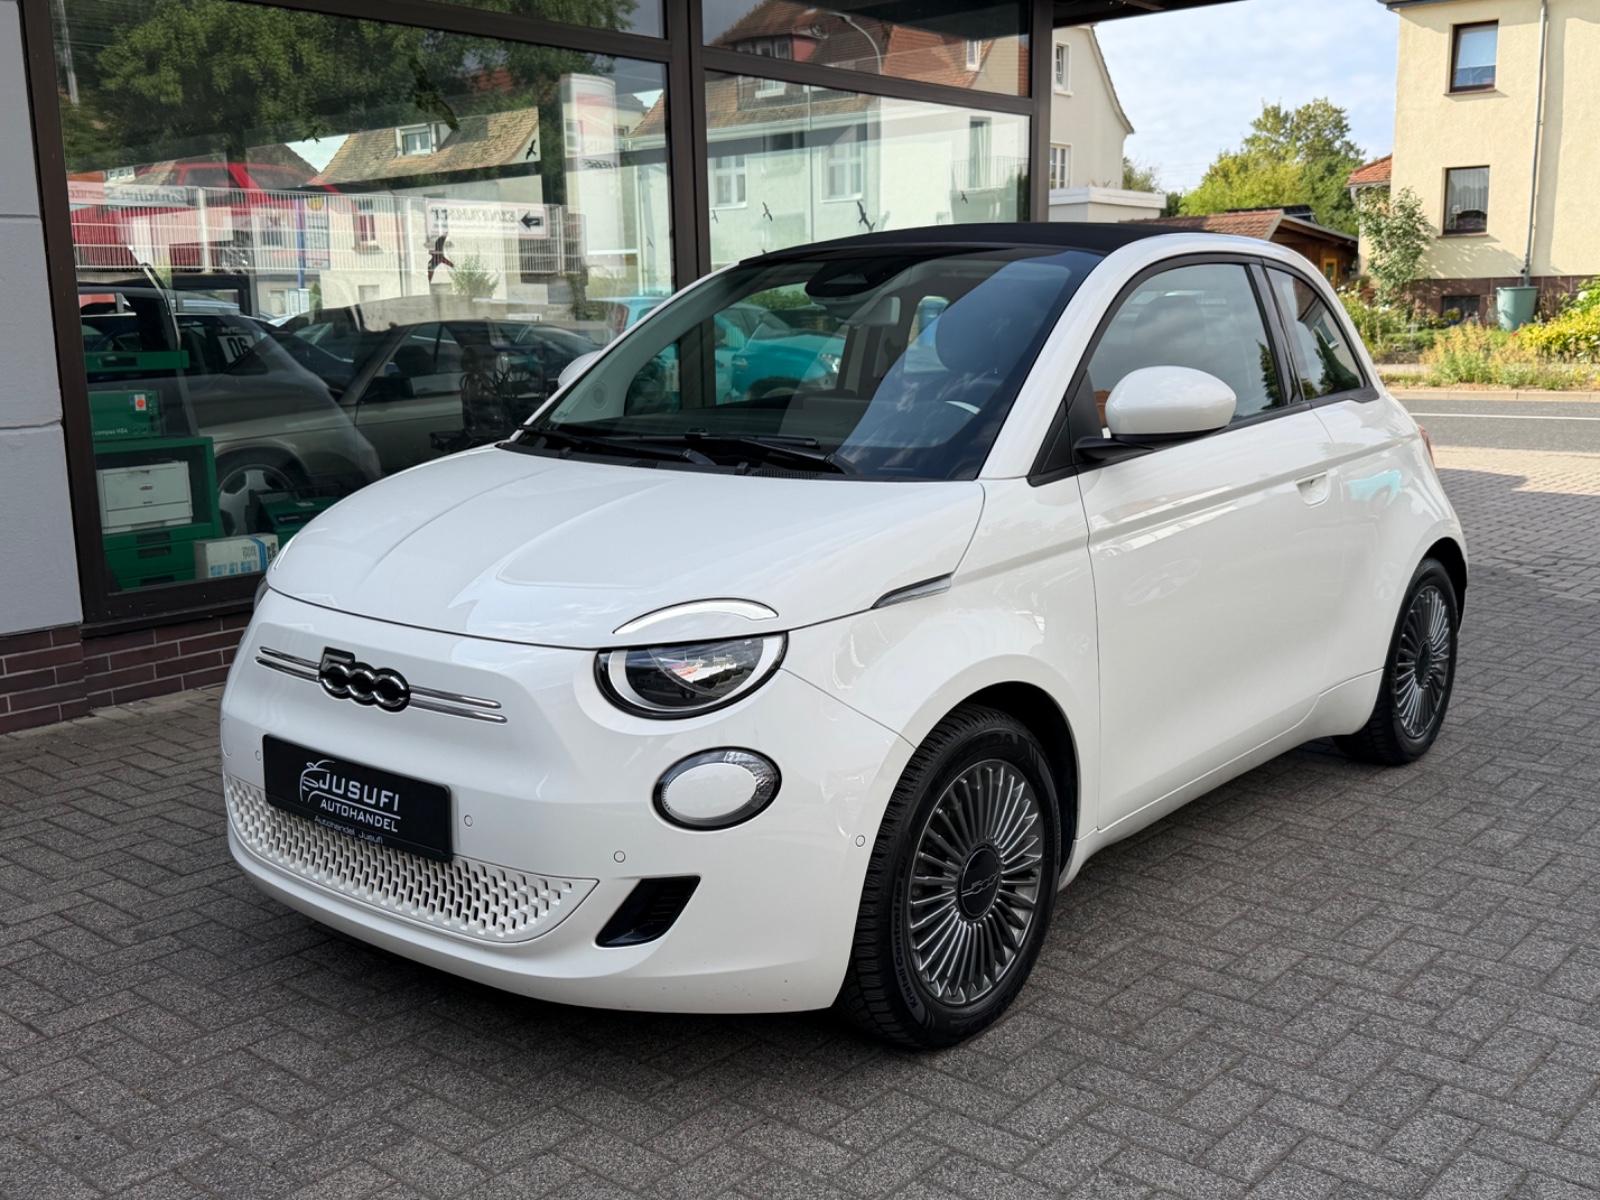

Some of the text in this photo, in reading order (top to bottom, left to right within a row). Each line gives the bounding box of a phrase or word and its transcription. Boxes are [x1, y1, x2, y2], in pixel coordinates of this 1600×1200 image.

[319, 646, 411, 713] 500
[319, 773, 400, 812] JUSUFI
[320, 798, 399, 833] AUTOHANDEL
[893, 906, 904, 967] Control
